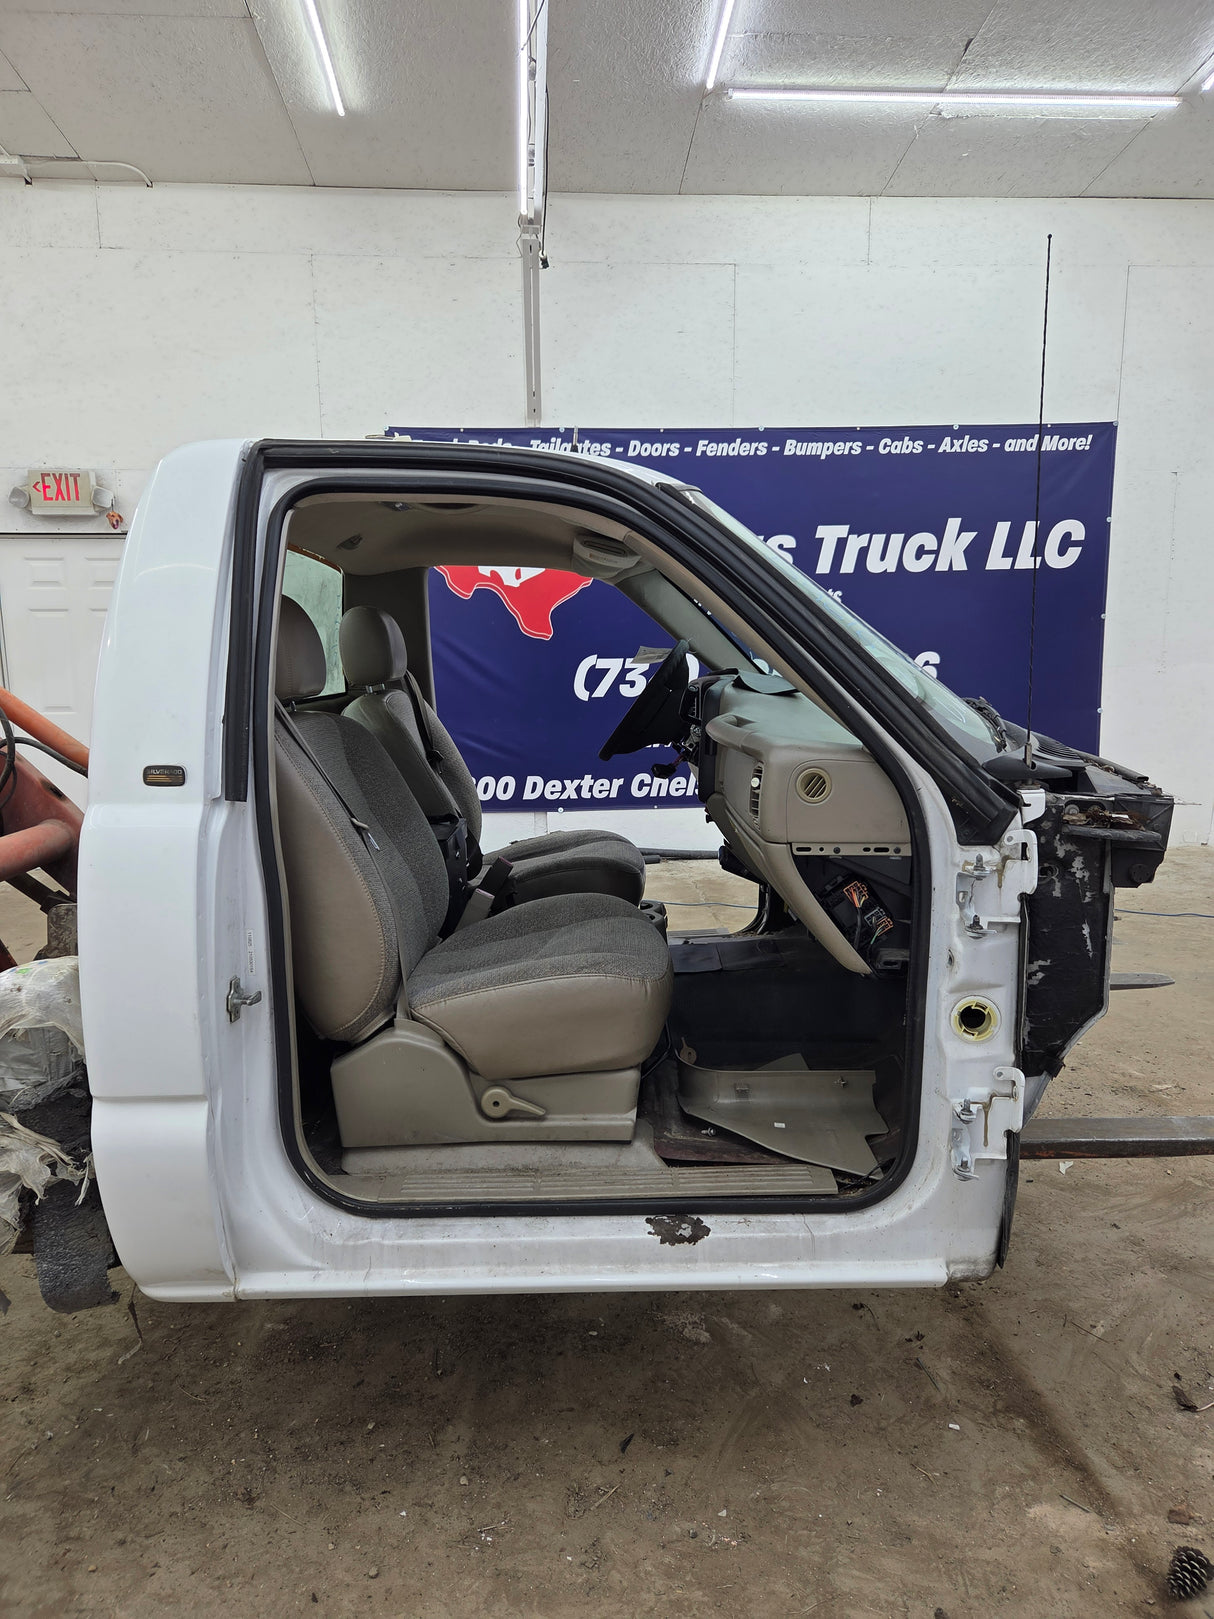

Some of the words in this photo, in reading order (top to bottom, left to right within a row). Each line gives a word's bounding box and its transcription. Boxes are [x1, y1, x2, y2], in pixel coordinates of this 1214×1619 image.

[627, 439, 681, 457] Doors
[696, 438, 768, 457] Fenders
[784, 439, 863, 459] Bumpers
[878, 437, 924, 454] Cabs
[937, 435, 989, 453] Axles
[1004, 434, 1040, 452] and
[1040, 434, 1094, 451] More!
[40, 473, 80, 501] EXIT
[815, 518, 978, 574] Truck
[985, 519, 1086, 570] LLC
[474, 776, 516, 801] 00
[523, 775, 624, 800] Dexter
[631, 772, 699, 797] Chel
